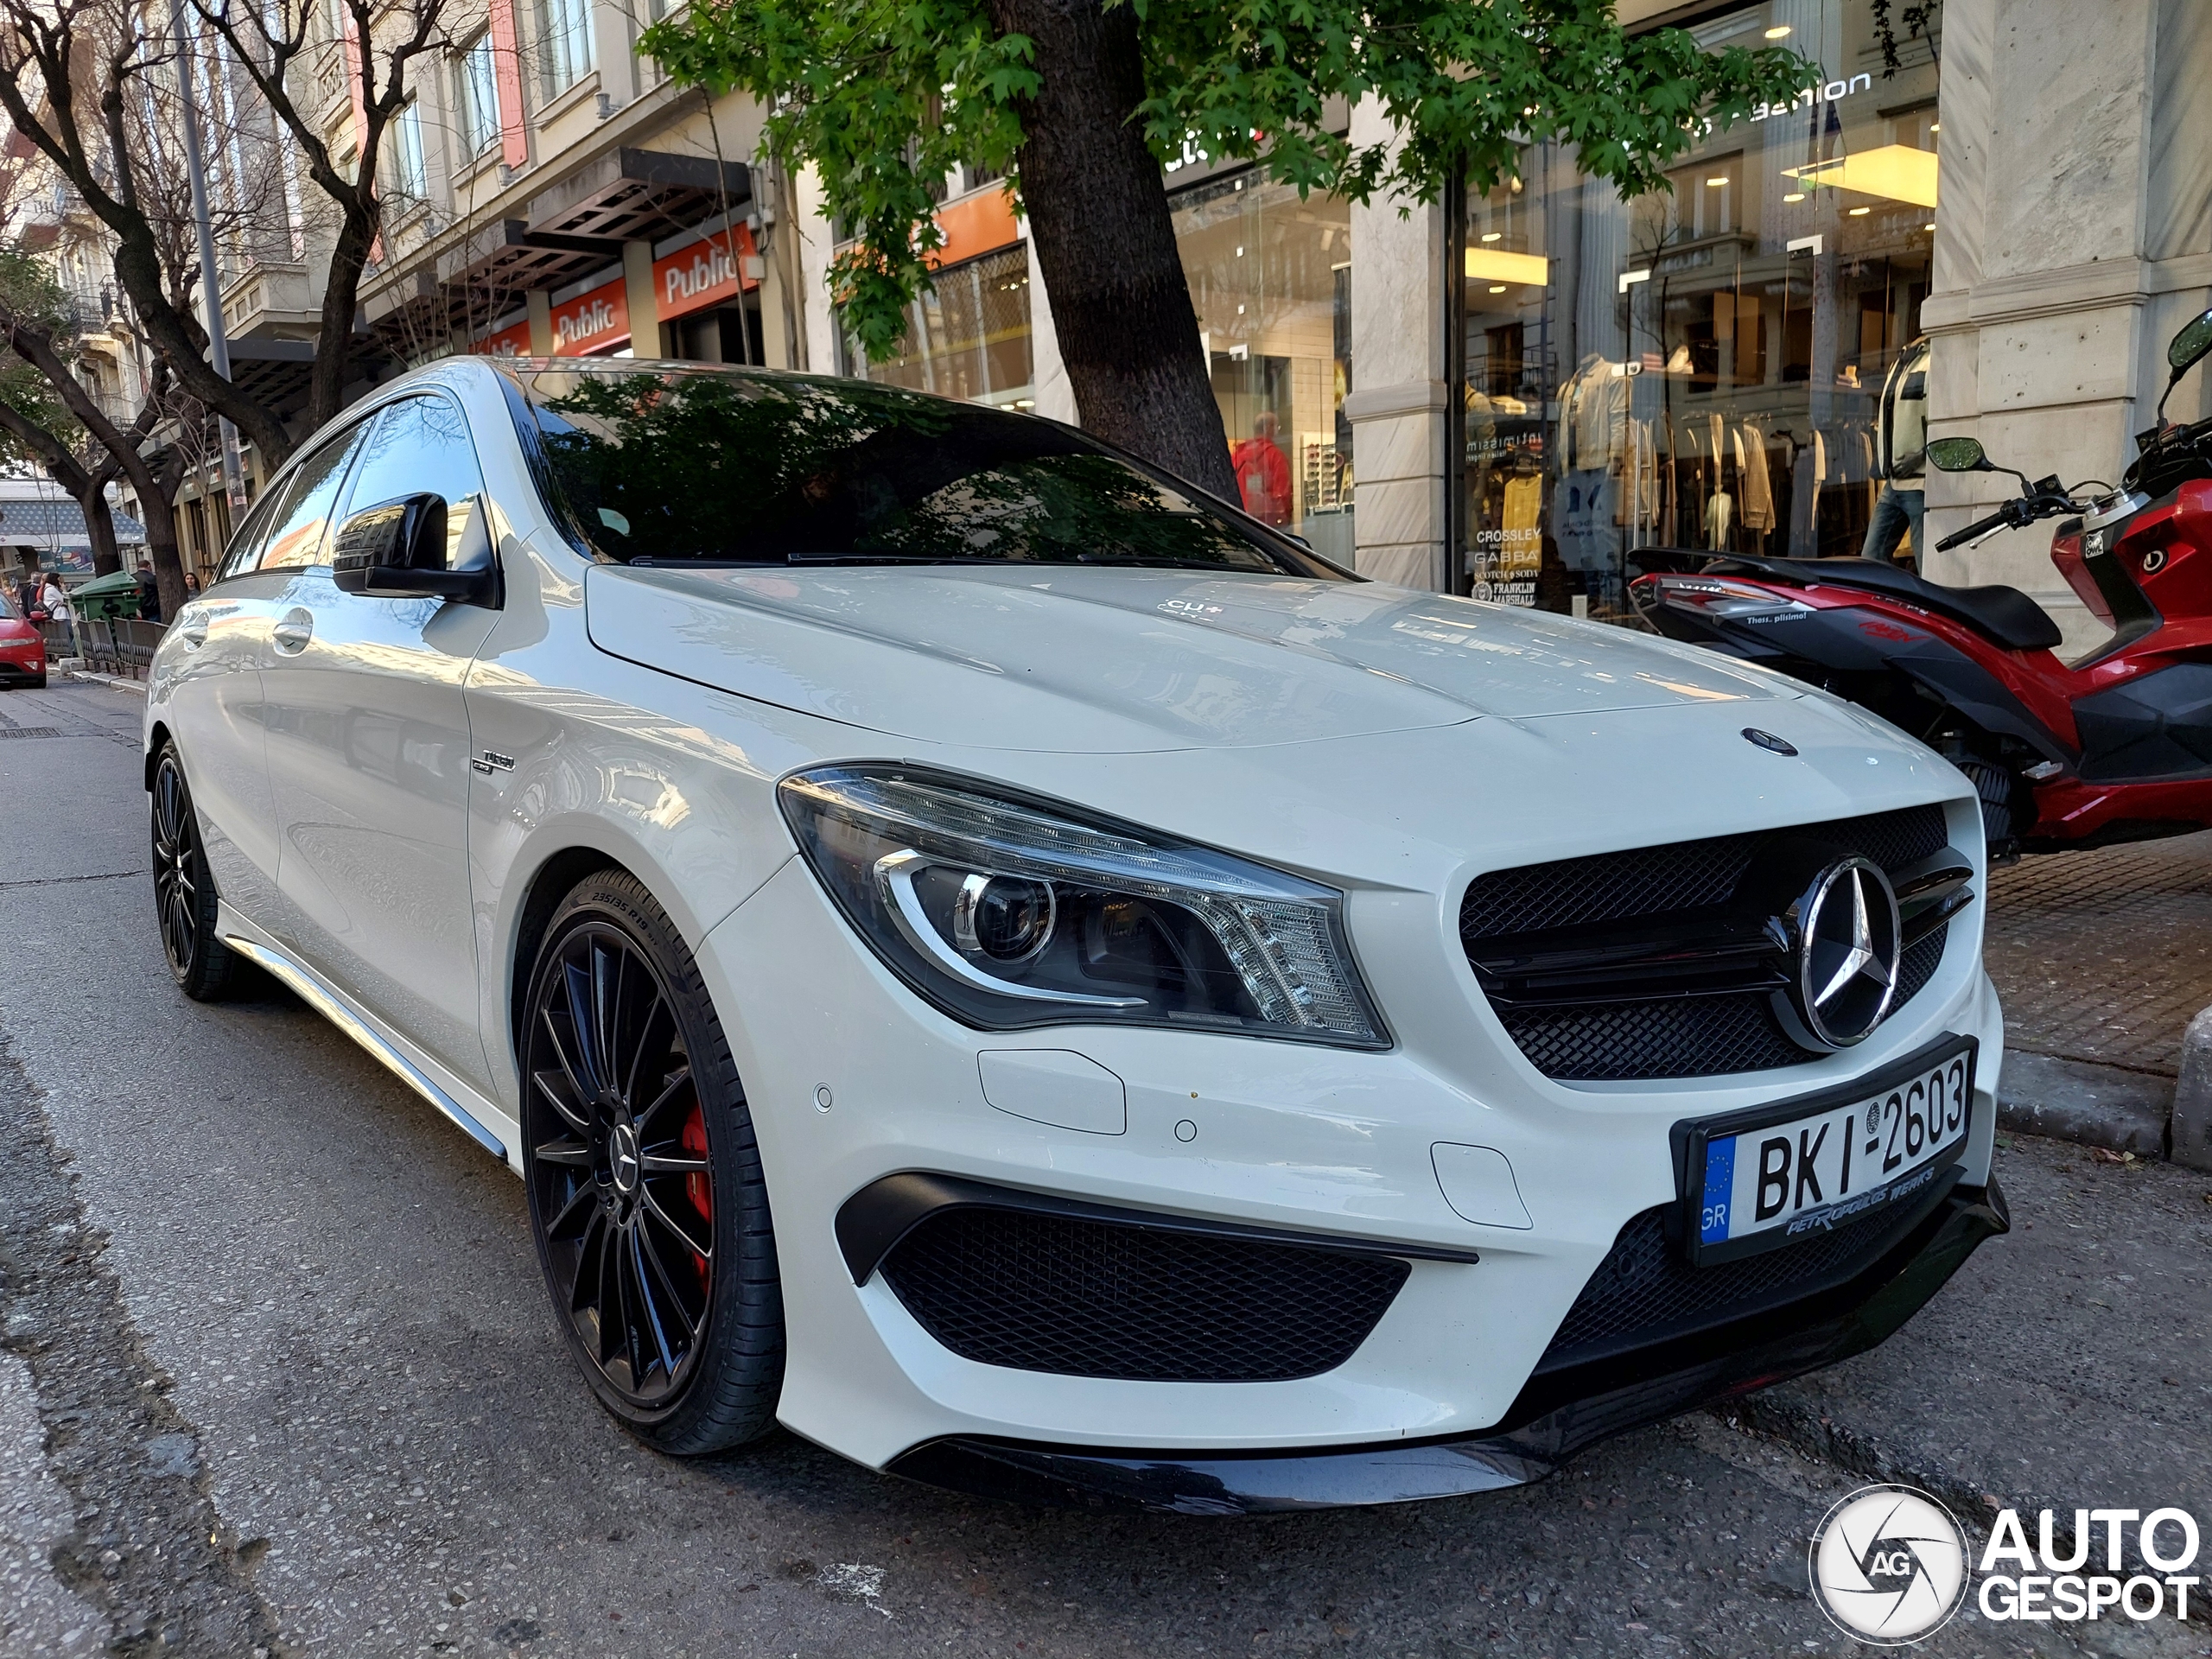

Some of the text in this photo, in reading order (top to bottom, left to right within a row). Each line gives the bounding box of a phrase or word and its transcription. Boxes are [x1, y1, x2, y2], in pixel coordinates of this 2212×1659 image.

[664, 247, 737, 304] Public
[558, 299, 616, 347] Public
[1476, 528, 1541, 543] CROSSLEY
[1474, 550, 1538, 564] GABBA
[1474, 570, 1506, 580] SCOTCH
[1516, 569, 1538, 579] SODA
[1493, 582, 1536, 594] FRANKLIN
[1493, 594, 1536, 606] MARSHALL
[592, 893, 629, 912] 235/35
[628, 909, 648, 931] R19
[1890, 1166, 1935, 1202] WERKS
[1701, 1204, 1726, 1231] GR
